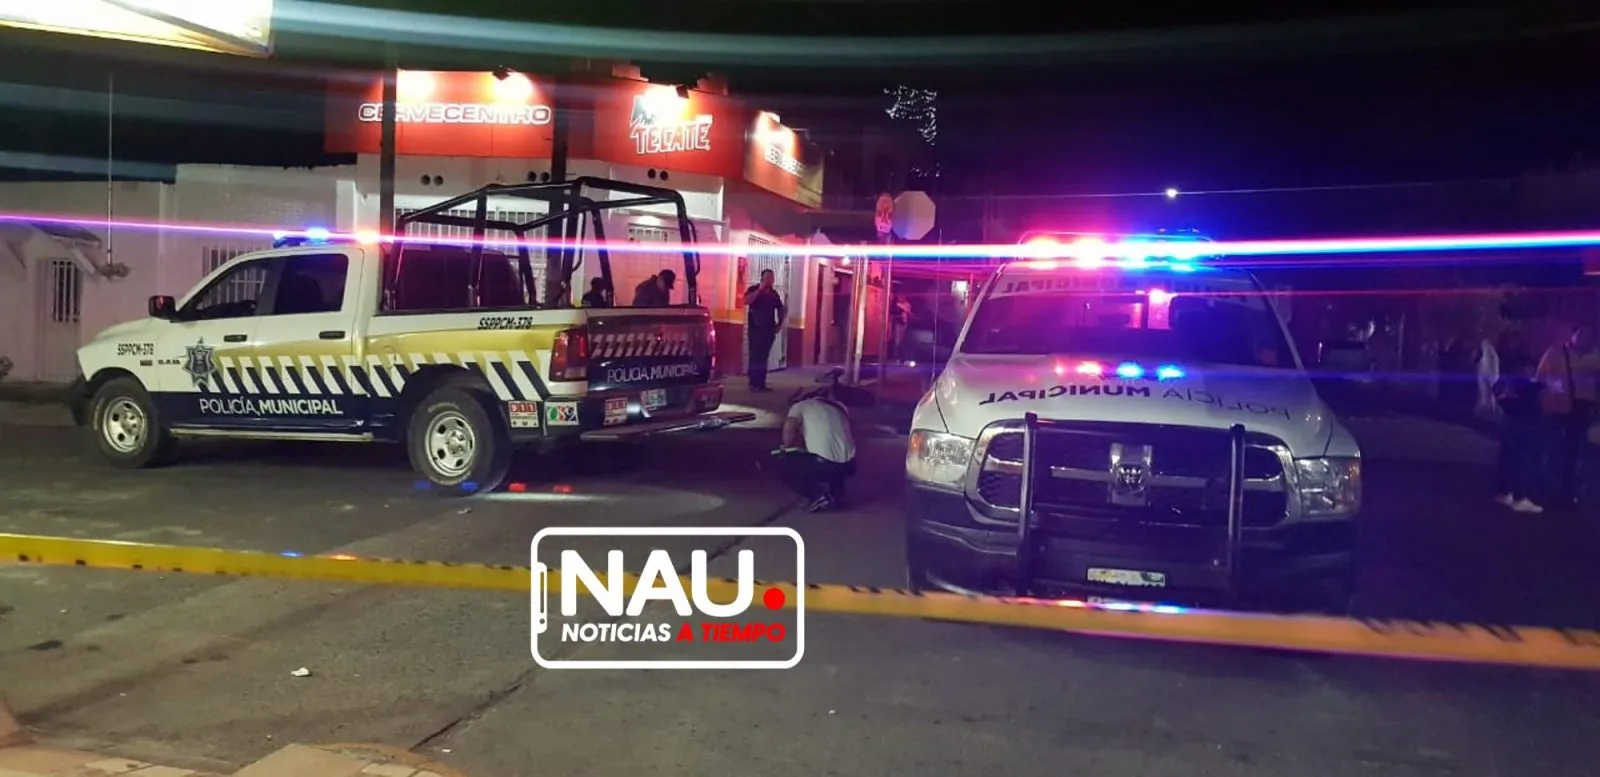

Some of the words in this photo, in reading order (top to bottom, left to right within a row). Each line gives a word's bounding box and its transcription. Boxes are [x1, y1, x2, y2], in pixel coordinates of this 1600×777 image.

[630, 119, 713, 155] TECATE
[478, 316, 533, 330] SSPPCM-378
[258, 399, 344, 415] MUNICIPAL
